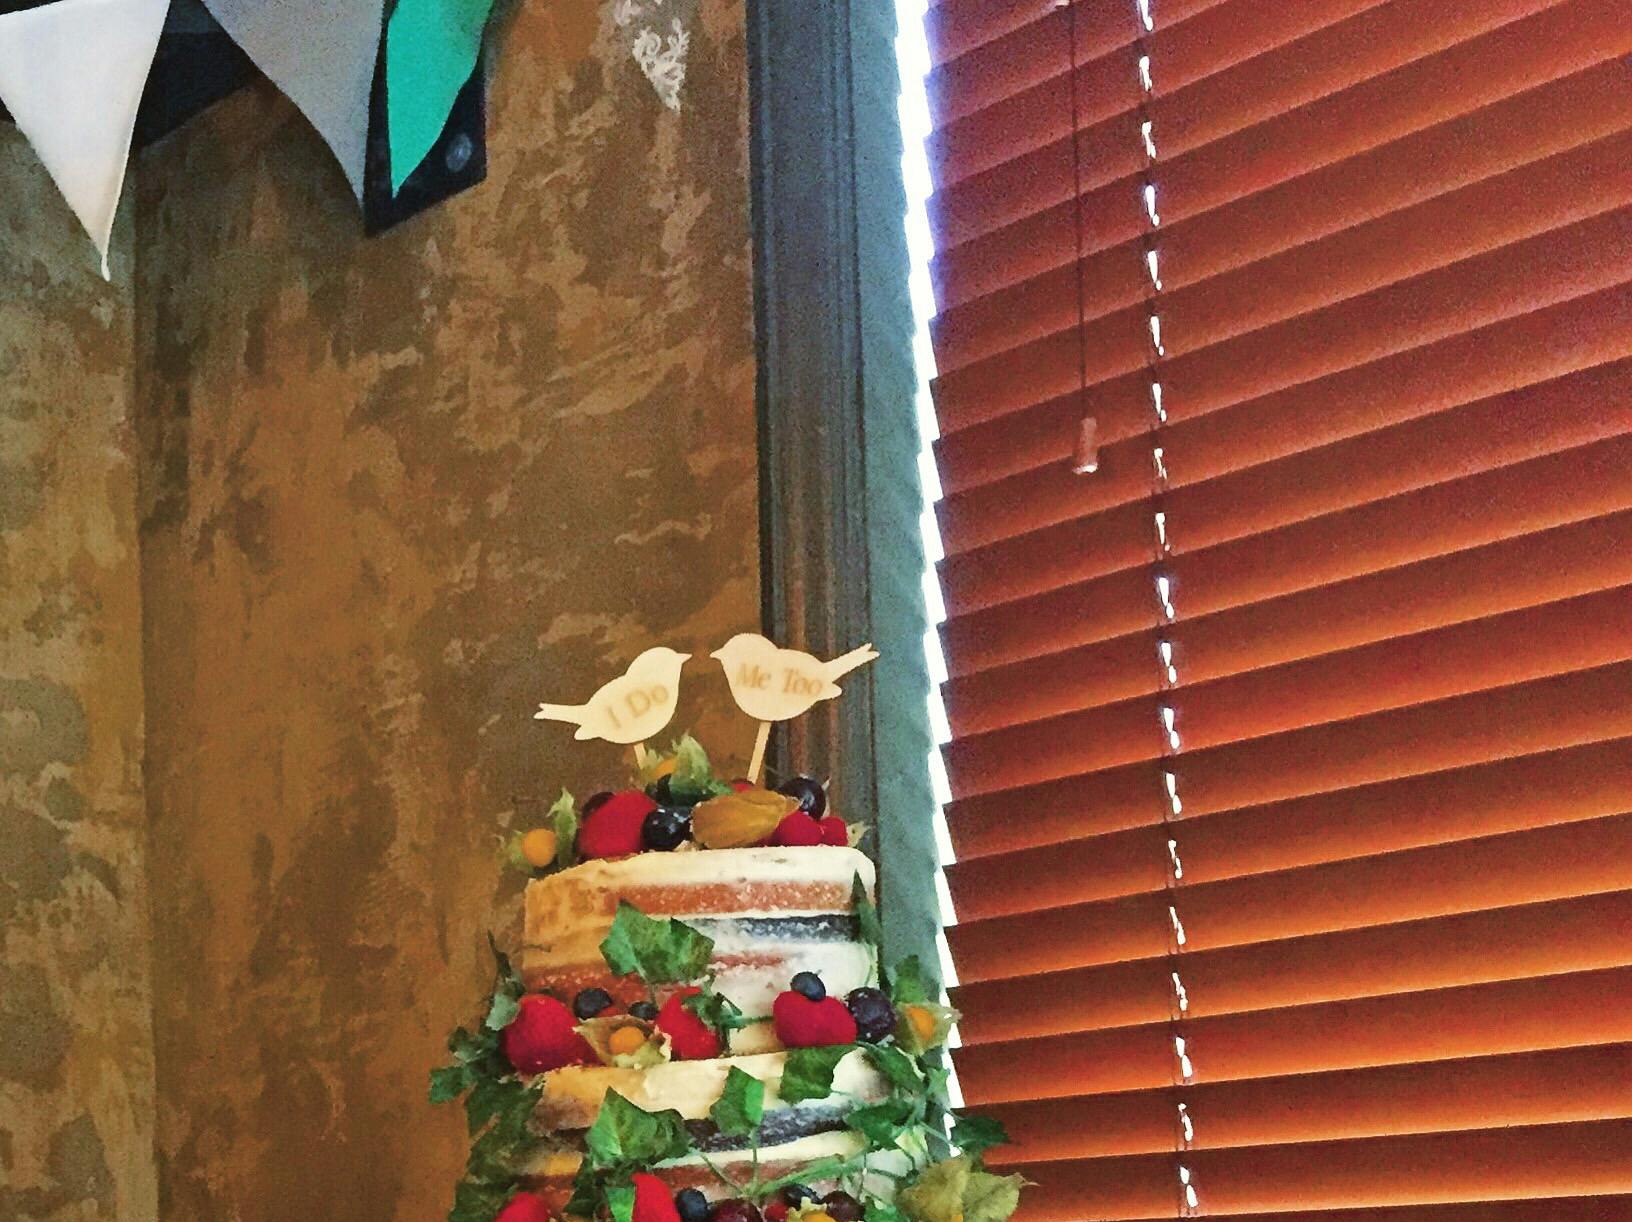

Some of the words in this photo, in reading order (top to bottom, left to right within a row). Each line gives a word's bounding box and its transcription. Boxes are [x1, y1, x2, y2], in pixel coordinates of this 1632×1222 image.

[735, 662, 772, 690] Me
[782, 667, 824, 696] Too
[607, 704, 622, 729] I
[624, 684, 669, 719] Do
